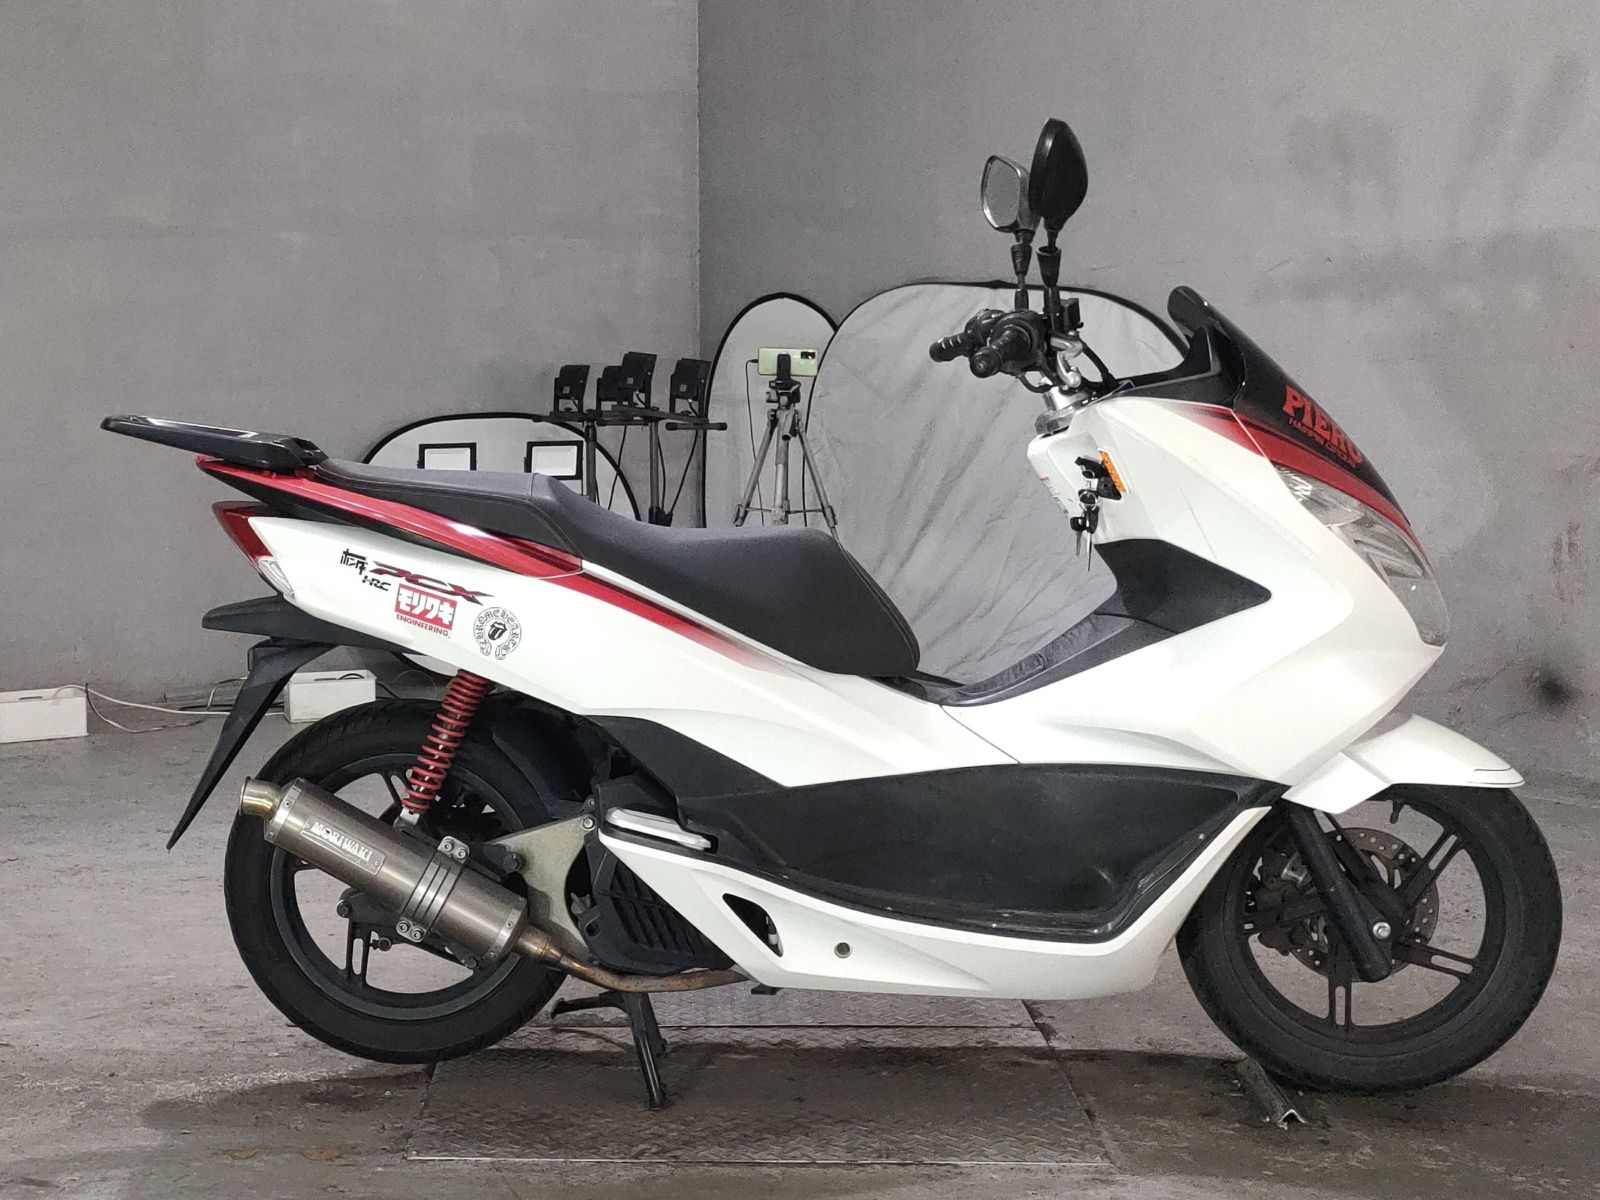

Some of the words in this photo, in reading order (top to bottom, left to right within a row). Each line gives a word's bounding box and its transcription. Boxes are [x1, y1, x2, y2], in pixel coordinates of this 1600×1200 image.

[362, 575, 391, 591] HRC
[369, 561, 495, 606] PCX
[396, 614, 449, 637] ENGINEERING
[399, 587, 456, 626] モリワキ
[310, 821, 373, 862] MORIWAKI
